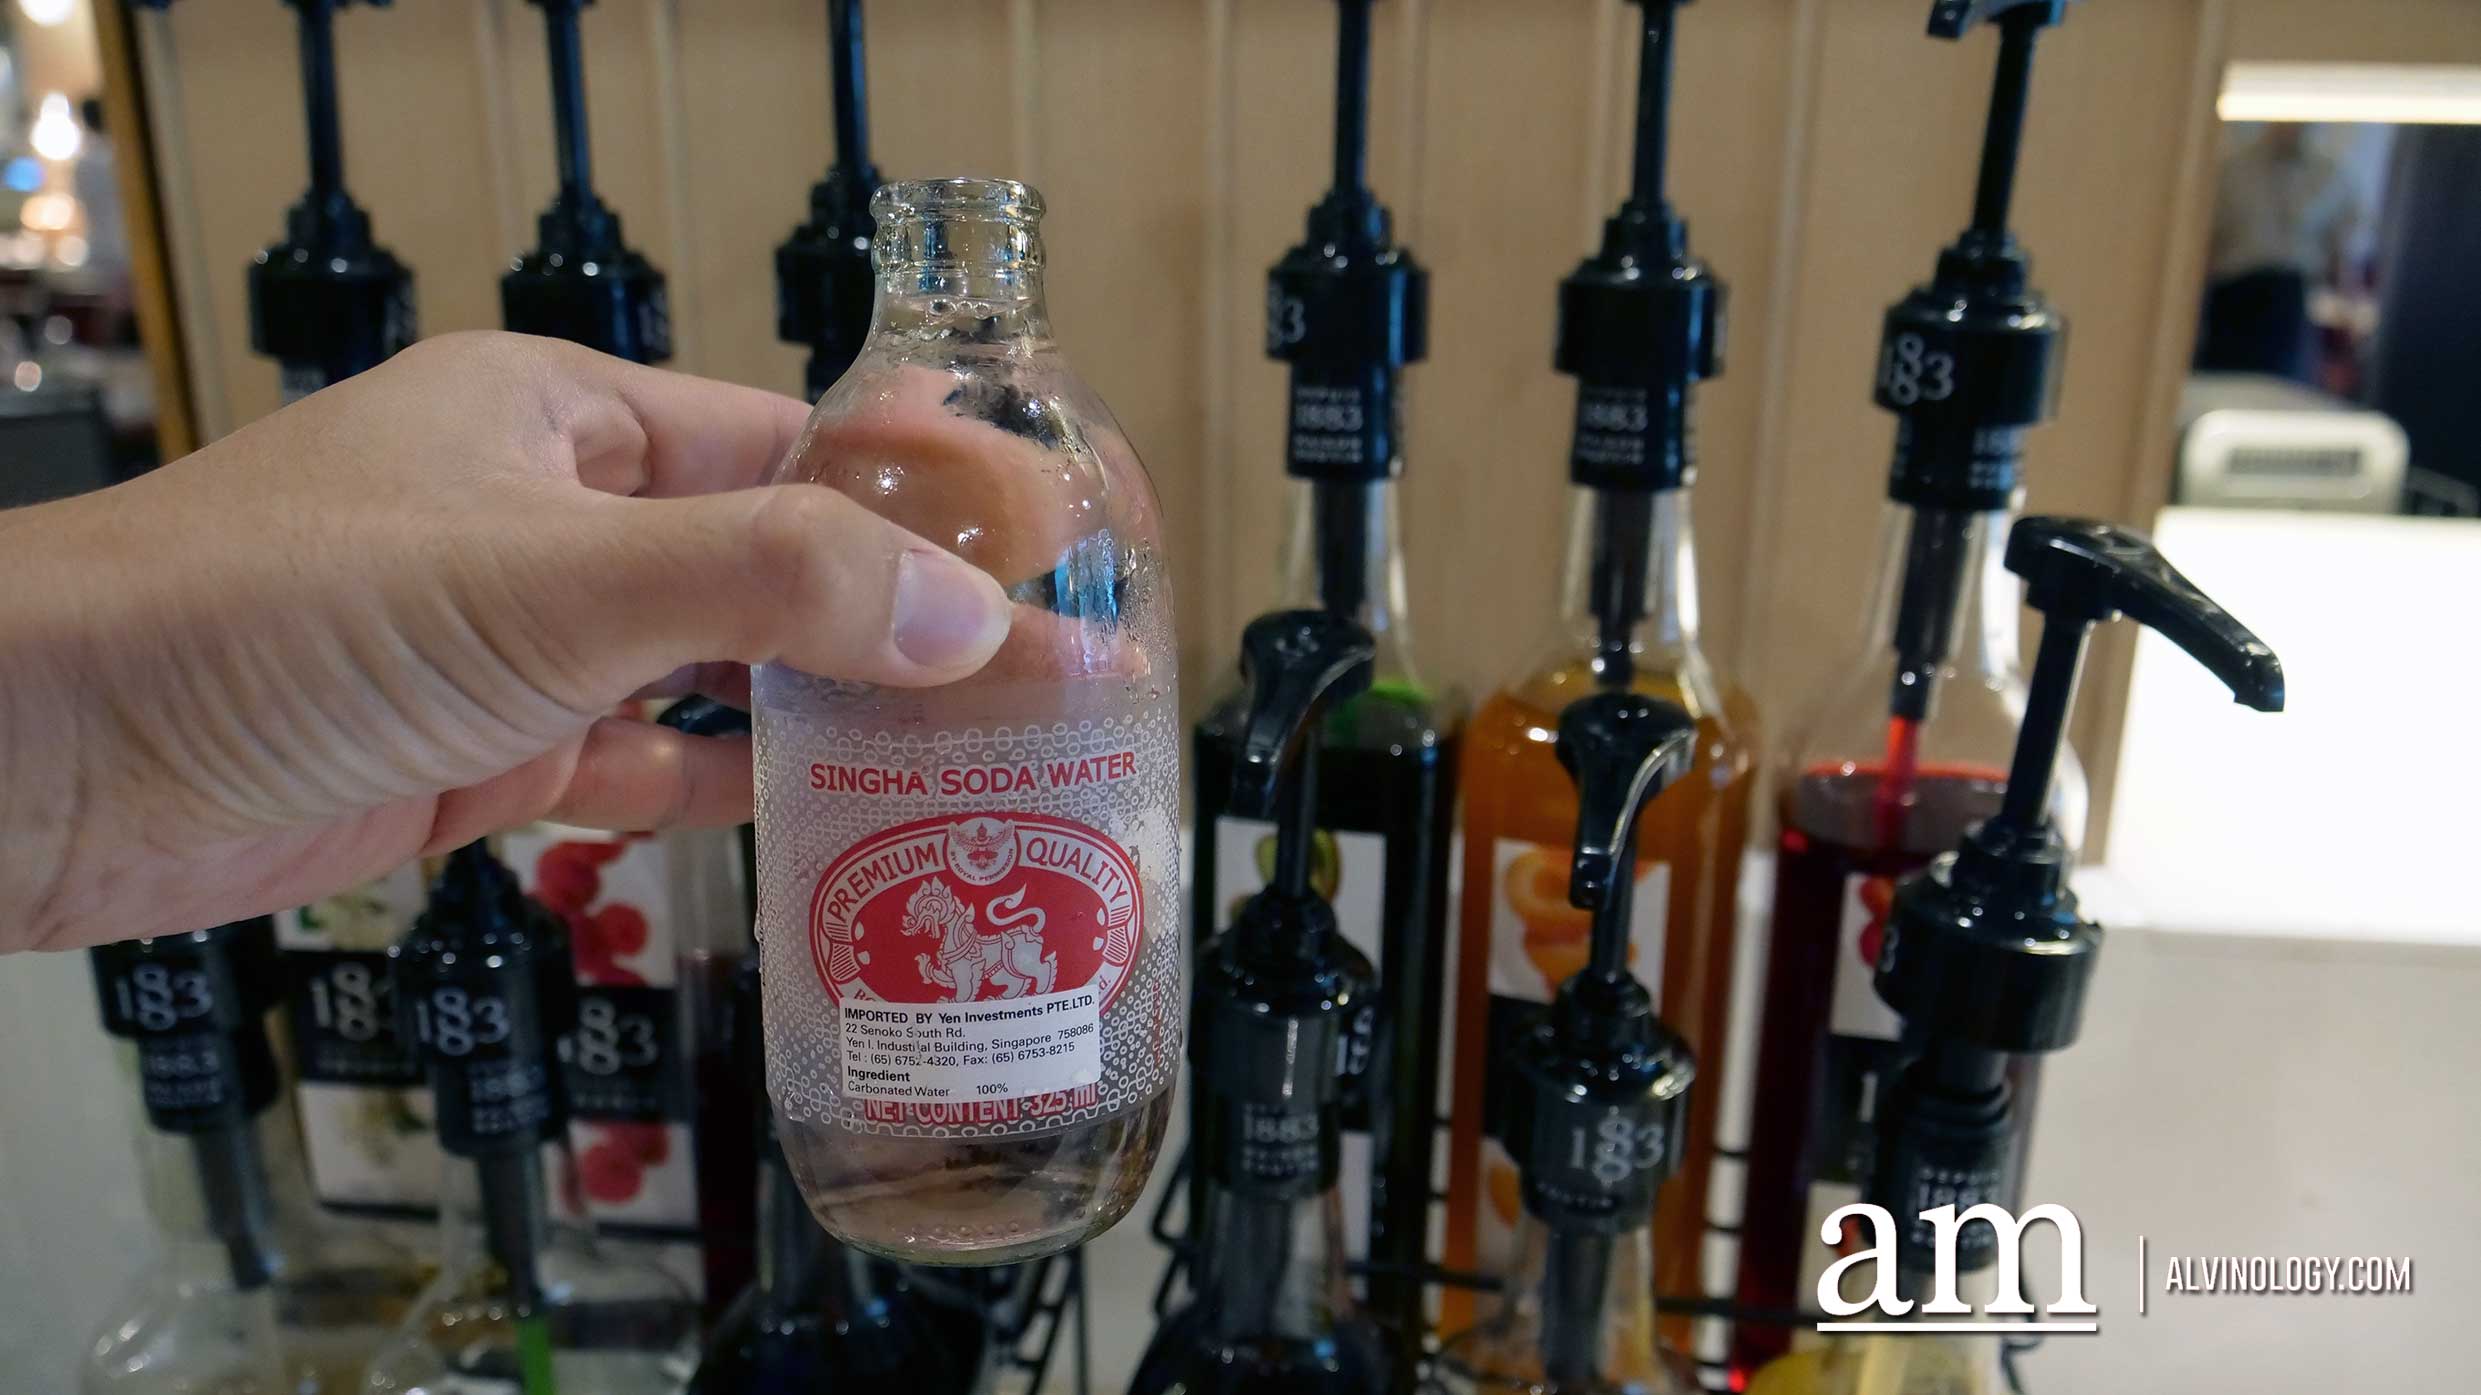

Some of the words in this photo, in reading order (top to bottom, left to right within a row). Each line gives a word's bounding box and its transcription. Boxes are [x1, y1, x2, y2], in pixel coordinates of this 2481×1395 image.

[810, 763, 929, 796] SINGHA
[941, 766, 1037, 796] SODA
[1047, 751, 1137, 788] WATER
[827, 842, 940, 923] PREMIUM
[1026, 837, 1129, 904] QUALITY
[954, 863, 977, 881] ROYAL
[844, 1007, 909, 1024] IMPORTED
[915, 1012, 933, 1024] BY
[938, 1012, 961, 1024] Yen
[964, 1005, 1044, 1023] Investments
[1046, 994, 1096, 1014] PTE.LTD.
[845, 1022, 858, 1034] 22
[860, 1024, 903, 1038] Senoko
[906, 1026, 942, 1039] South
[946, 1027, 966, 1038] Rd.
[846, 1036, 865, 1049] Yen
[934, 1041, 988, 1053] Building,
[991, 1034, 1052, 1051] Singapore
[1058, 1022, 1094, 1041] 758086
[870, 1053, 892, 1066] (65)
[963, 1054, 988, 1066] Fax:
[991, 1051, 1015, 1065] (65)
[1017, 1041, 1075, 1061] 6753-8215
[847, 1065, 911, 1082] Ingredient
[847, 1080, 913, 1096] Carbonated
[914, 1085, 950, 1097] Water
[976, 1082, 1009, 1095] 100%
[915, 1098, 1019, 1122] CONTENT
[1031, 1090, 1067, 1116] 325
